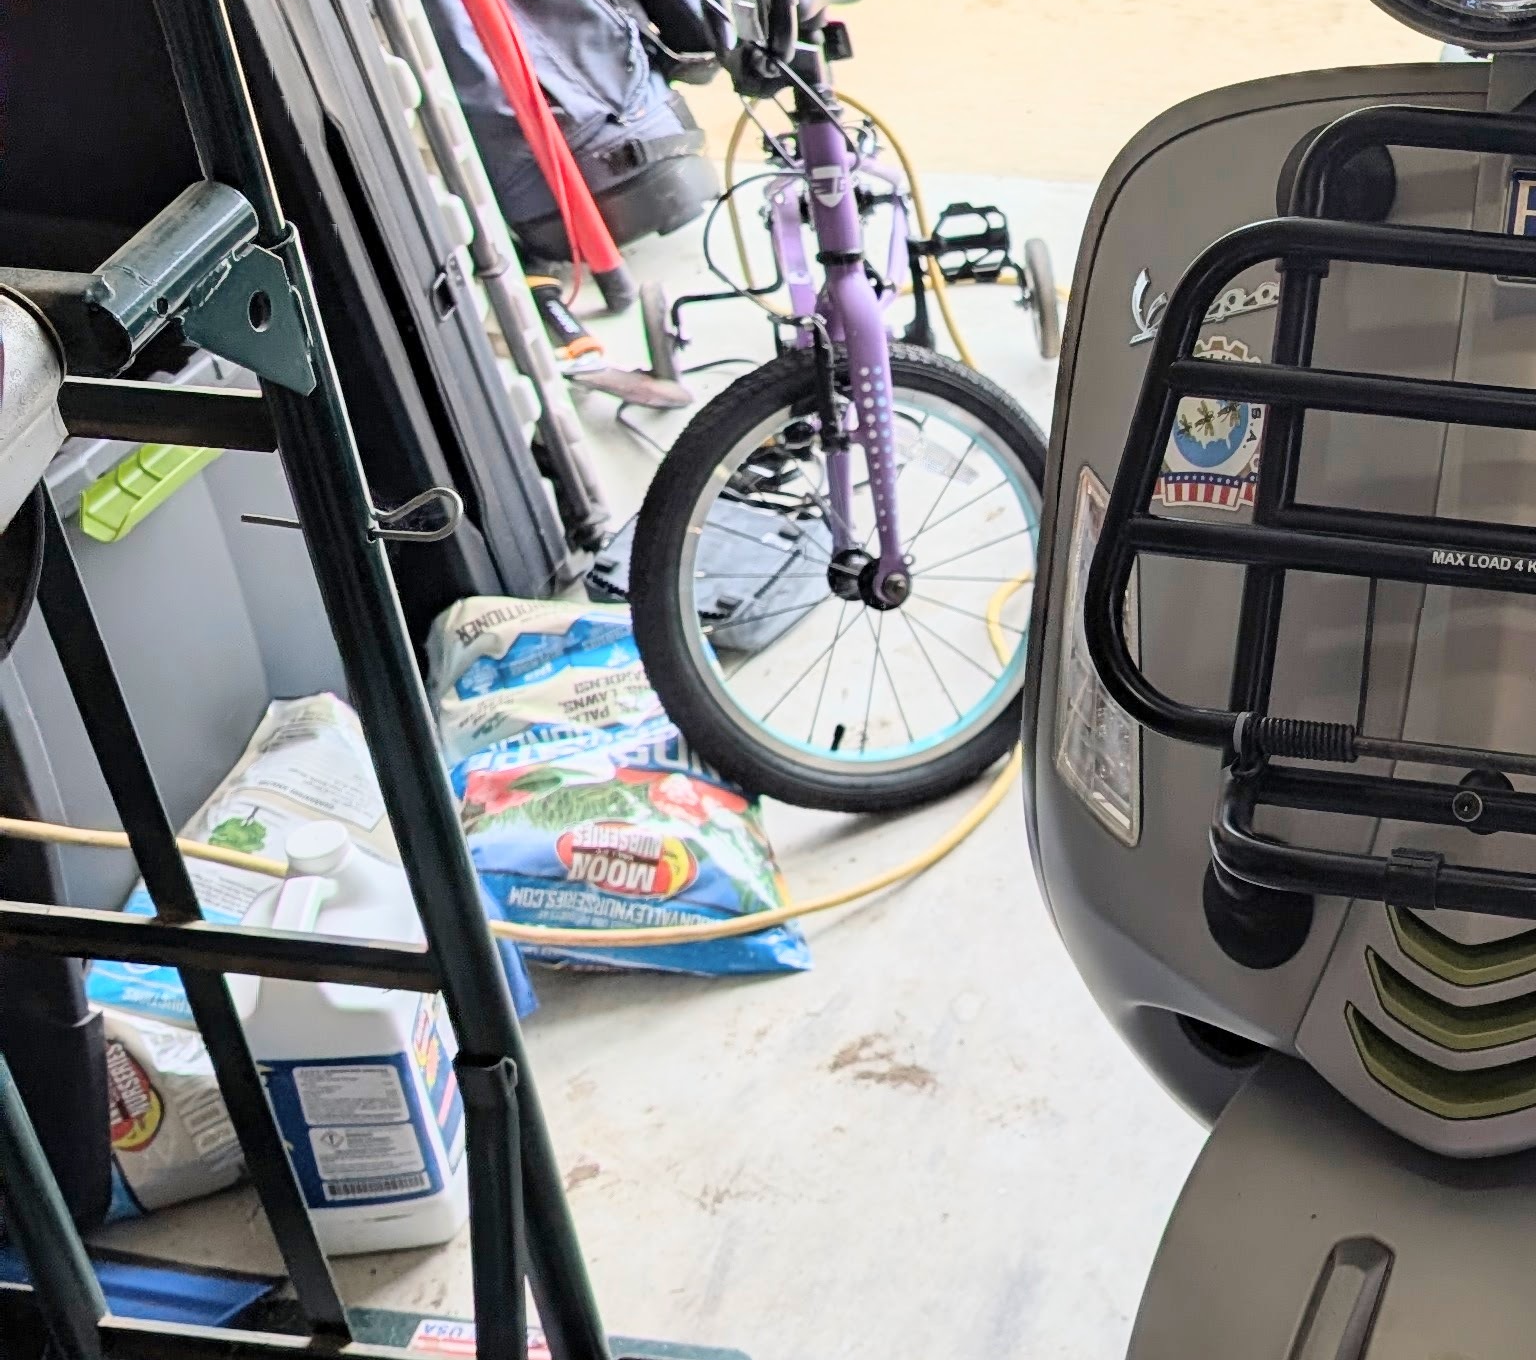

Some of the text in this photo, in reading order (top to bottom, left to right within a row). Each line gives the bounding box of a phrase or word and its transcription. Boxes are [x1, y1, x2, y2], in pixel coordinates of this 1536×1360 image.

[1432, 550, 1466, 567] MAX
[1468, 554, 1512, 571] LOAD
[1514, 559, 1524, 572] 4
[565, 851, 658, 894] MOON
